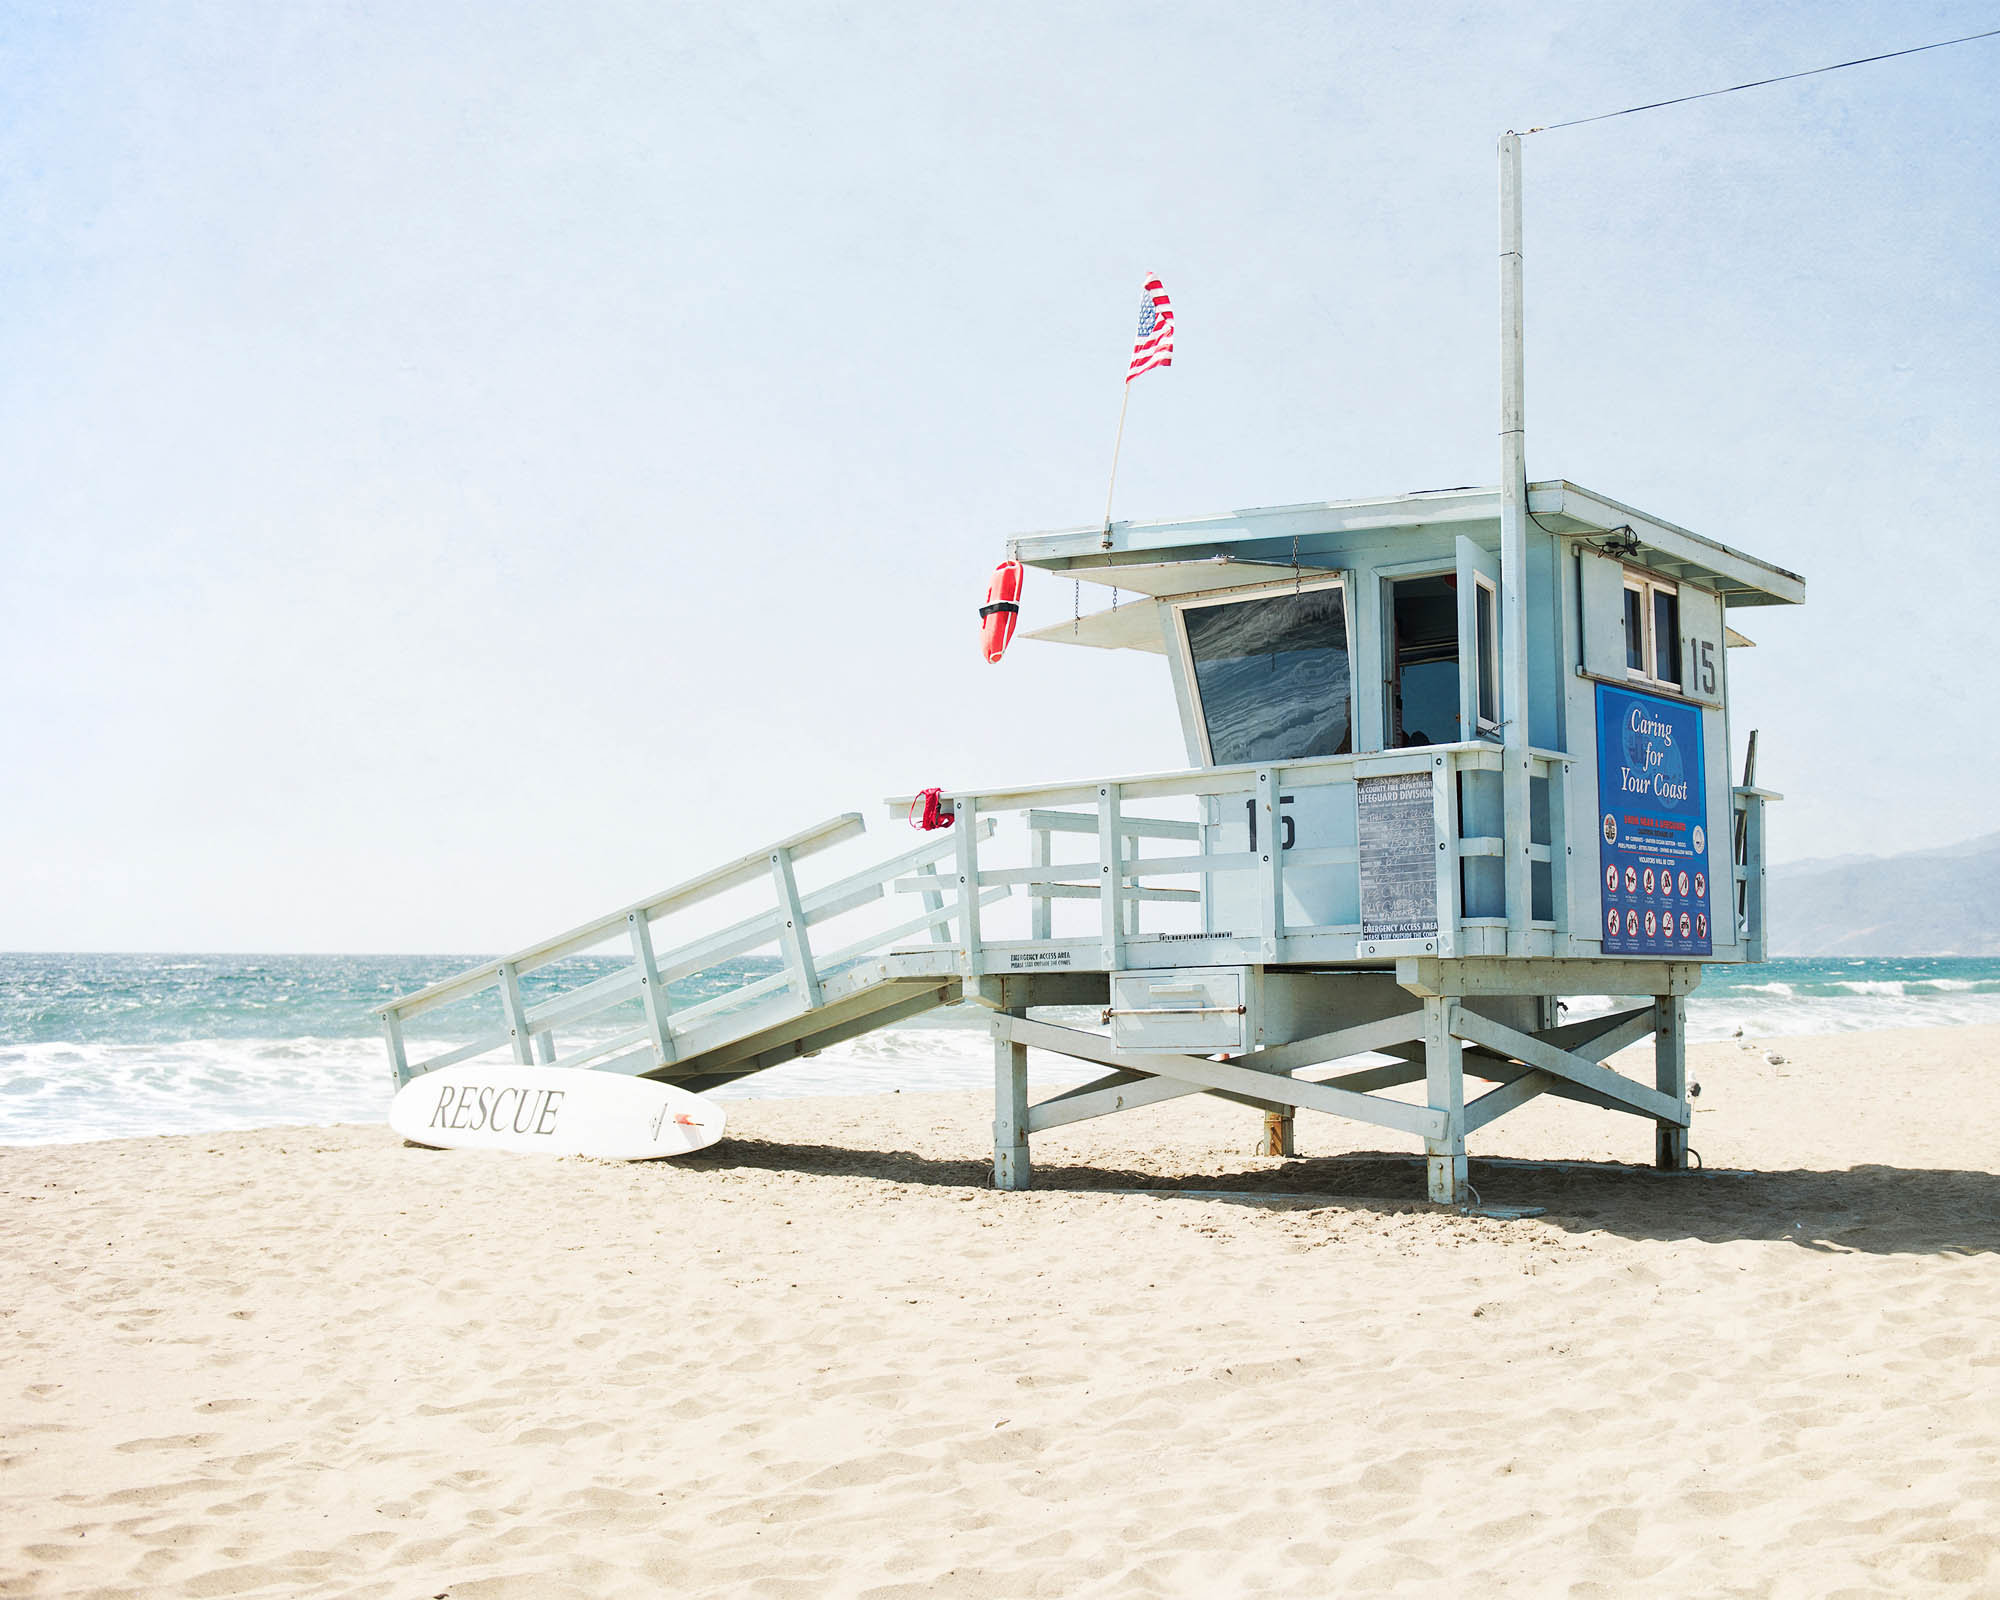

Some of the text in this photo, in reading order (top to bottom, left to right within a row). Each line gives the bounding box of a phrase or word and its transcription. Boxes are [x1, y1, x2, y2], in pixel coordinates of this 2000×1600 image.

[1691, 637, 1715, 695] 15
[1631, 708, 1672, 747] Caring
[1642, 741, 1664, 772] for
[1358, 791, 1398, 804] LIFEGUARD
[1400, 788, 1433, 800] DIVISION
[1365, 785, 1386, 793] COUNTY
[1400, 780, 1433, 790] DEPARTMENT
[1620, 766, 1688, 801] Your Coast
[1363, 921, 1437, 934] EMERGENCY ACCESS AREA
[1010, 953, 1038, 961] EMERGENCY
[1039, 952, 1057, 960] ACCESS
[429, 1085, 565, 1135] RESCUE
